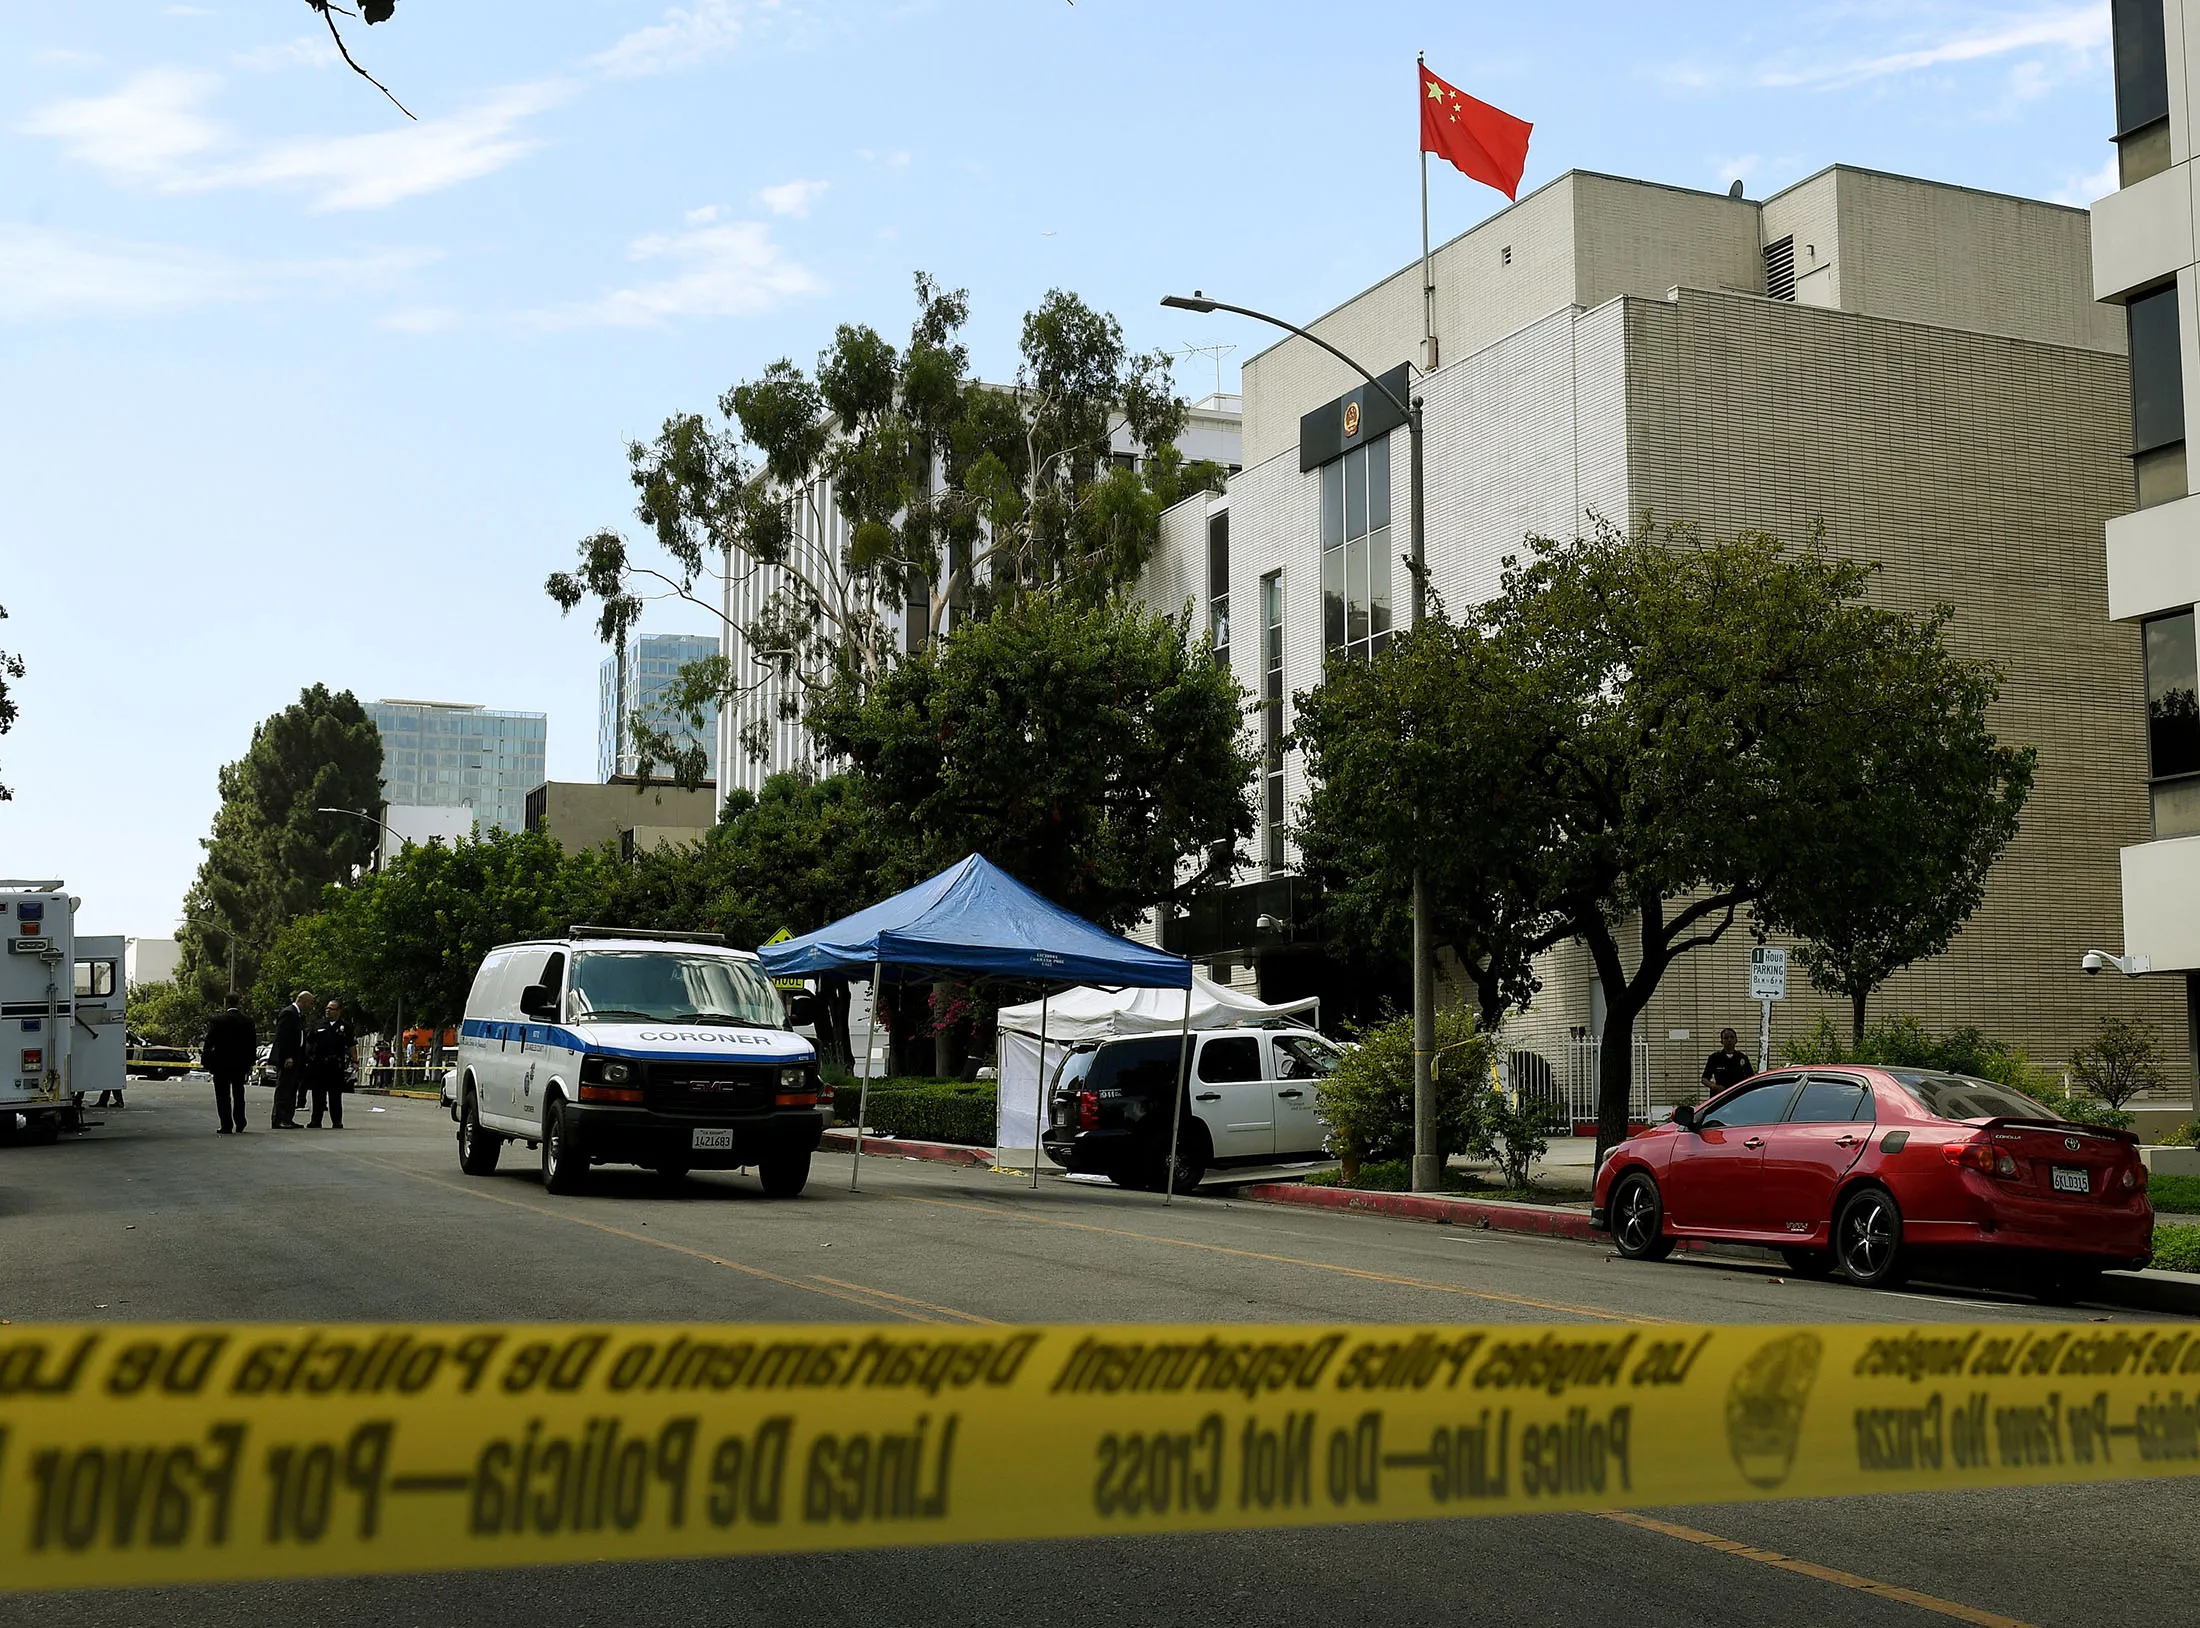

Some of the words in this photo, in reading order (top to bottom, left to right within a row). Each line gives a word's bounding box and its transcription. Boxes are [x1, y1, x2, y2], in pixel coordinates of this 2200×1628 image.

[1765, 953, 1784, 962] HOUR
[1753, 964, 1784, 975] PARKING
[774, 977, 801, 986] HOOL
[639, 1031, 772, 1046] CORONER
[689, 1080, 734, 1092] GMC
[695, 1136, 730, 1147] 1421683
[1995, 1133, 2021, 1141] COROLLA
[2055, 1174, 2088, 1190] 6KLD315
